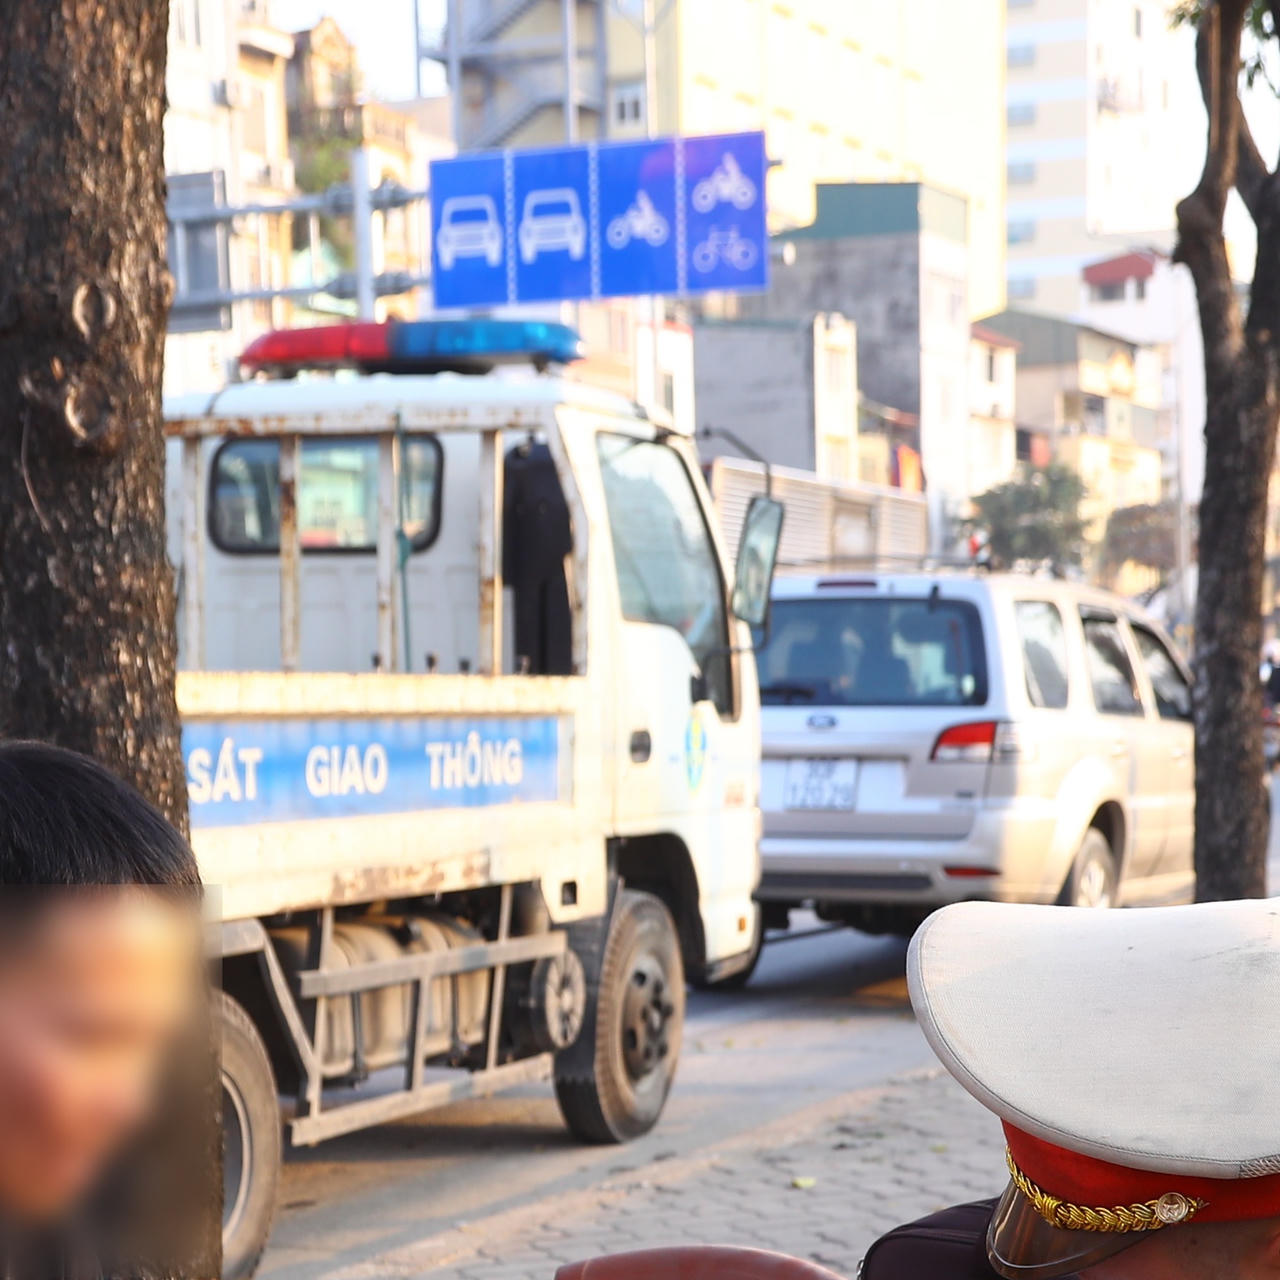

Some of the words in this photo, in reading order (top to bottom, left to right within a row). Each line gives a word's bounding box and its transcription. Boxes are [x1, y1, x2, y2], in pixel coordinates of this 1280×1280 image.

[186, 737, 264, 804] SÁT
[305, 743, 389, 798] GIAO
[425, 729, 524, 790] THÔNG
